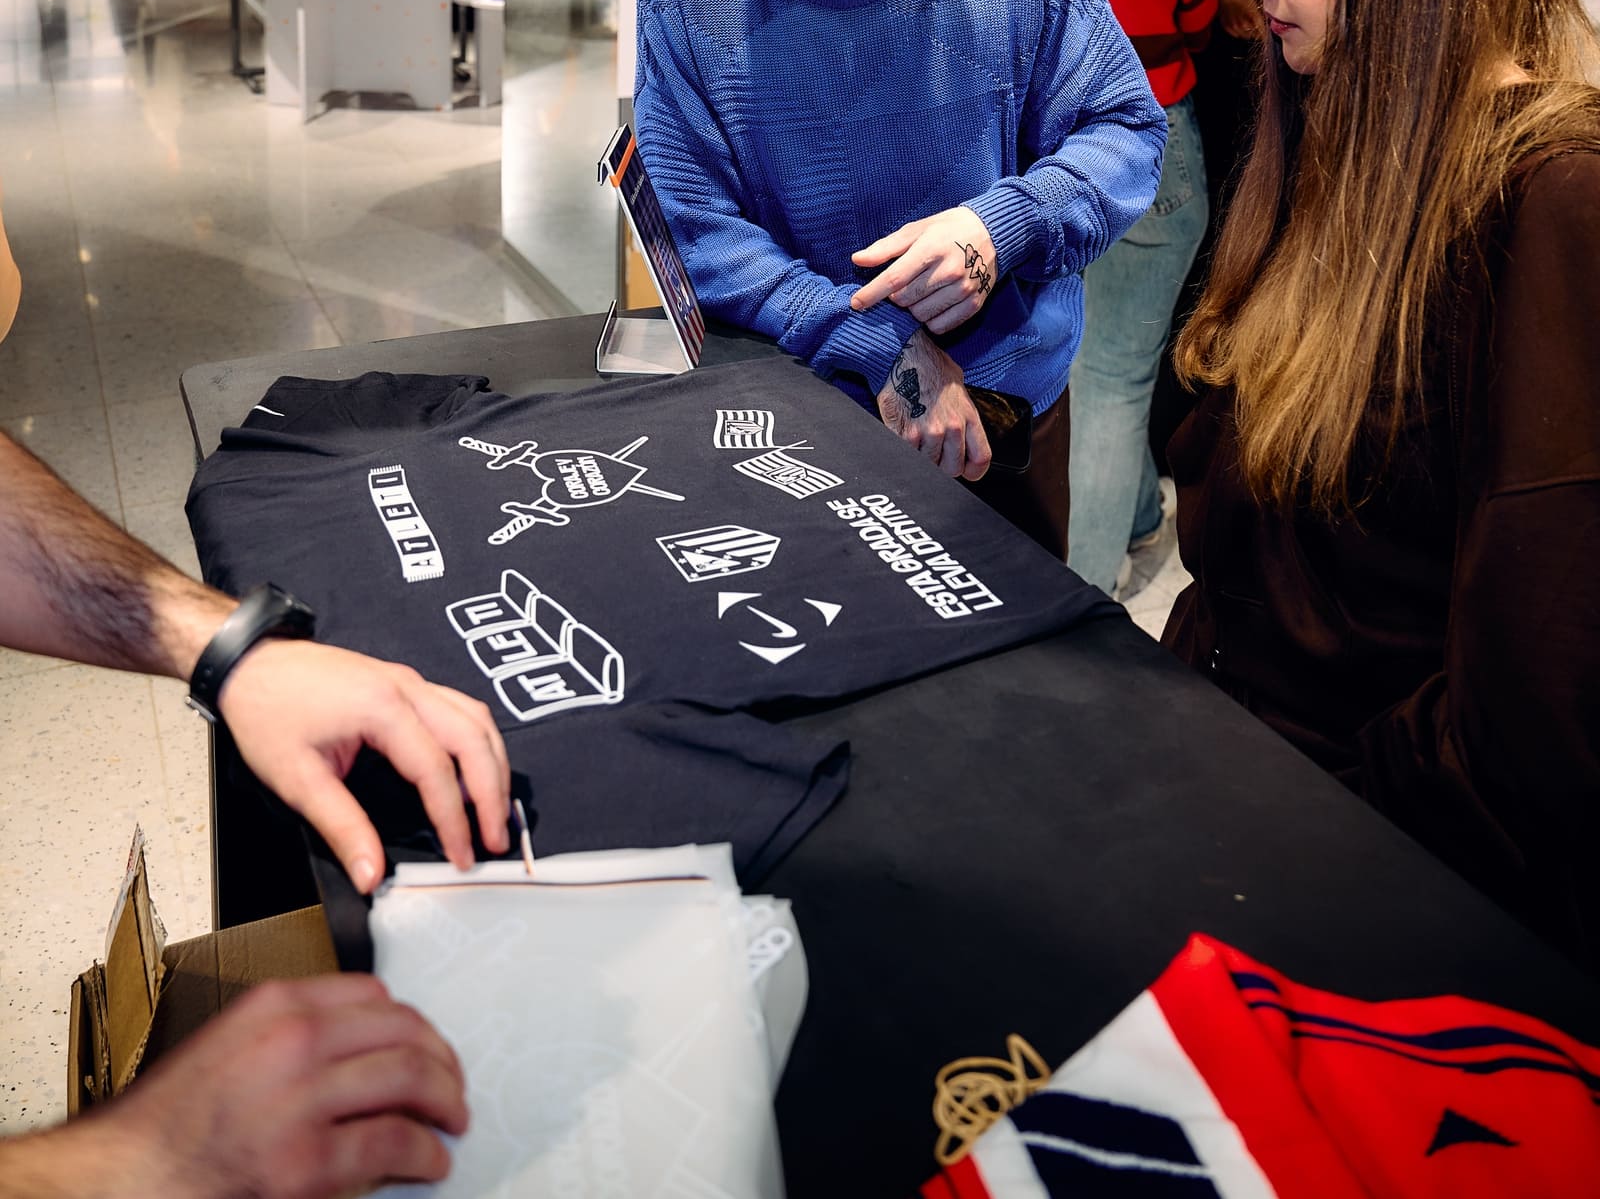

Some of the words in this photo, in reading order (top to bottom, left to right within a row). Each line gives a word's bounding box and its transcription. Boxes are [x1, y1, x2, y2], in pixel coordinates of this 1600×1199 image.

[376, 476, 436, 567] ATLETI
[826, 497, 867, 520] SE
[859, 493, 945, 556] DENTRO
[849, 516, 924, 573] GRADA
[905, 570, 973, 619] ESTA
[924, 552, 1004, 611] LLEVA
